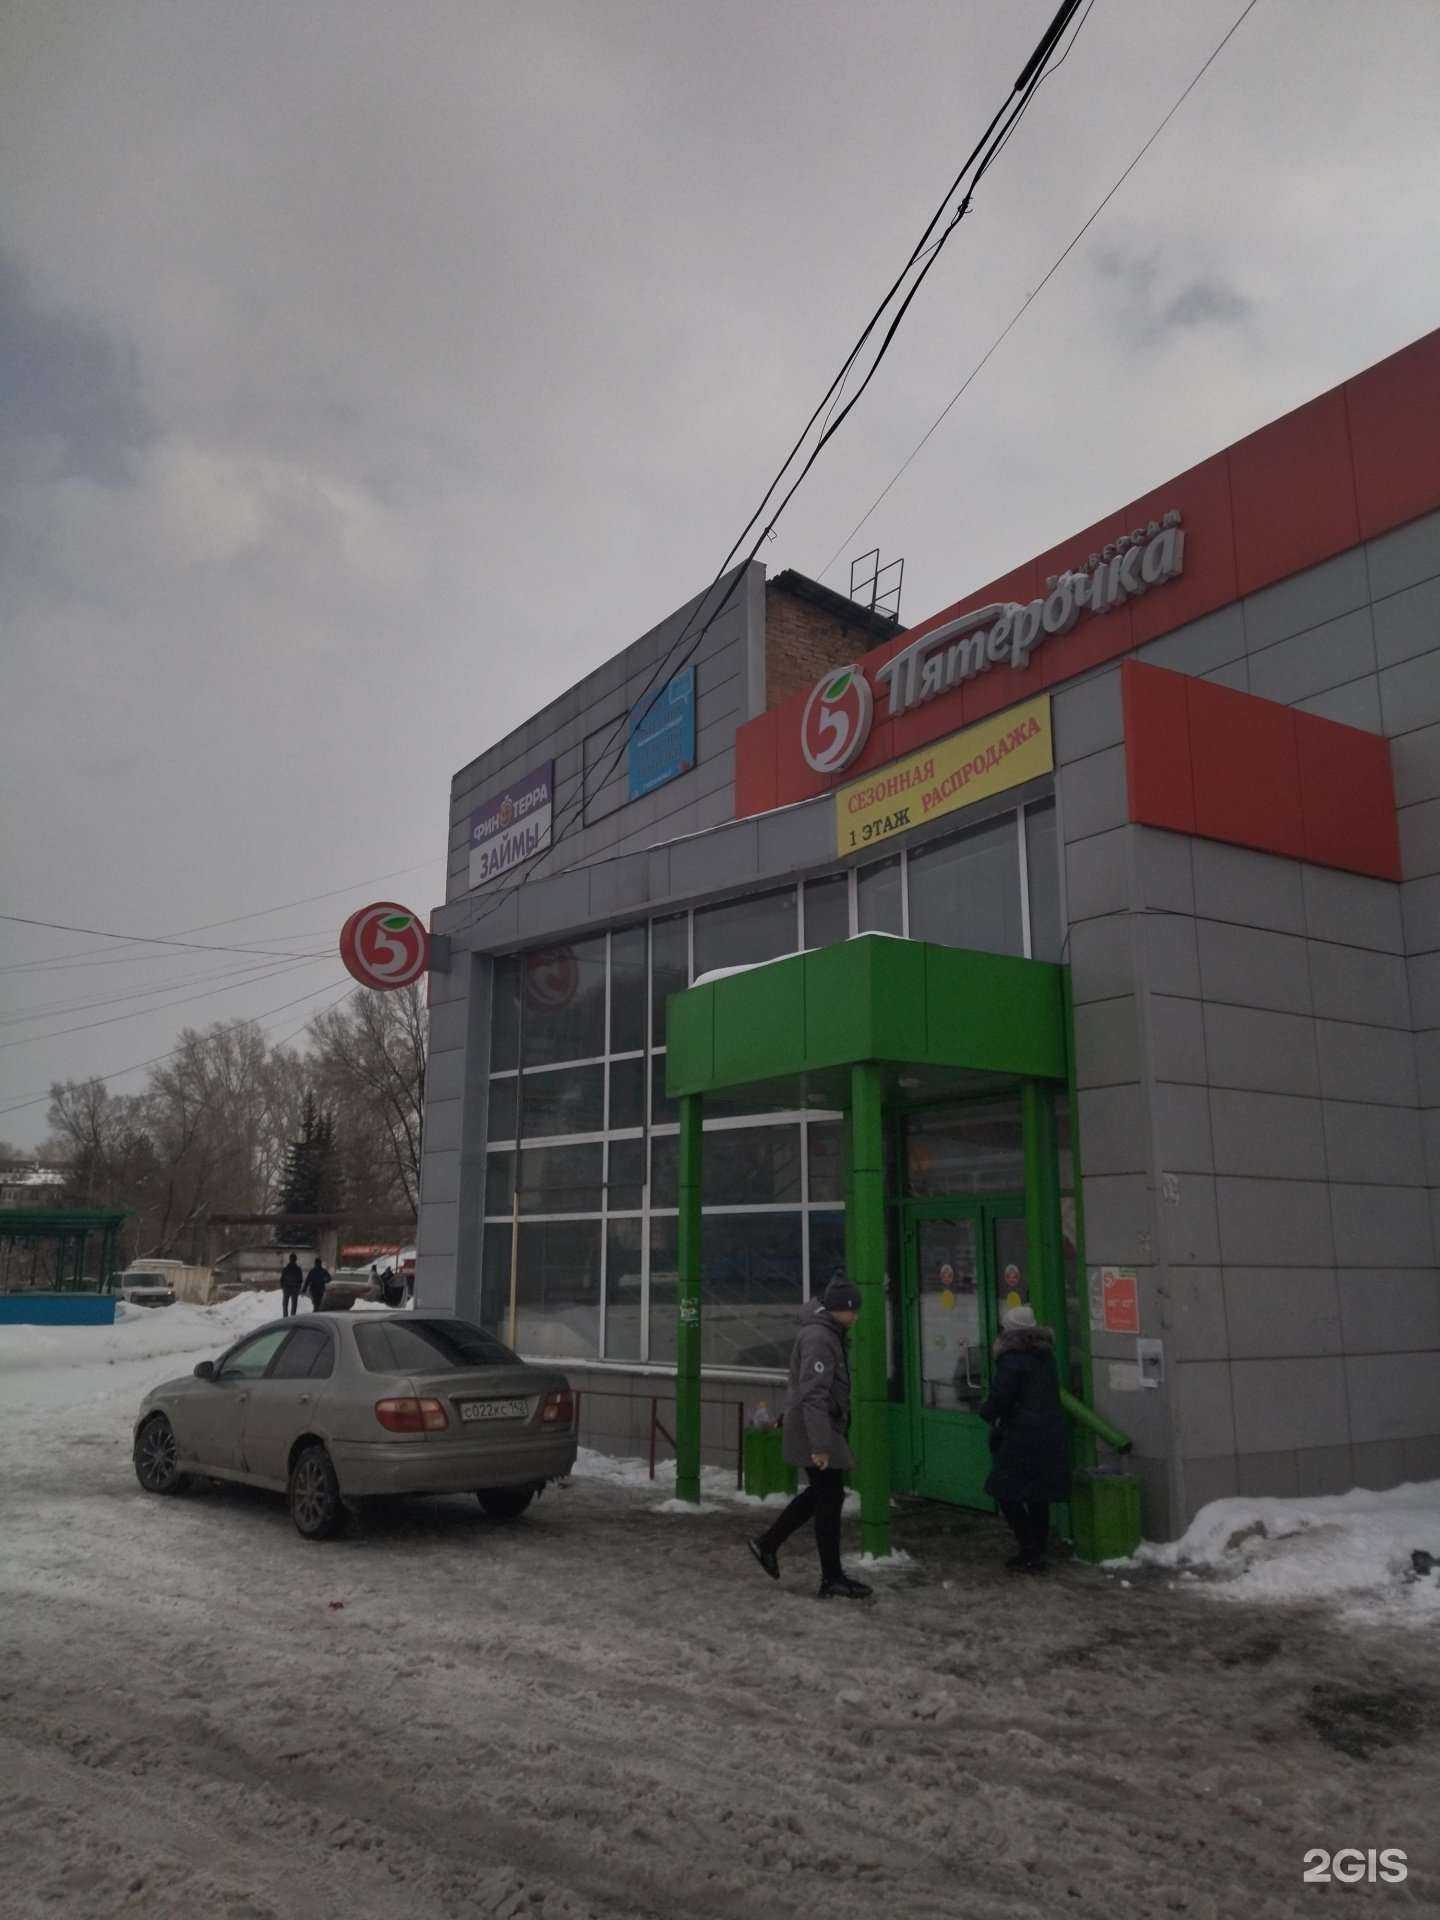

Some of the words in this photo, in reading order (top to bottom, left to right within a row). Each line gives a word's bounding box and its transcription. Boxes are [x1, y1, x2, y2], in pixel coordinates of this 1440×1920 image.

[848, 759, 935, 814] СЕЗОННАЯ
[921, 716, 1041, 813] РАСПРОДАЖА
[480, 822, 540, 880] ЗАЙМЫ
[849, 831, 857, 846] 1
[862, 807, 911, 841] ЭТАЖ
